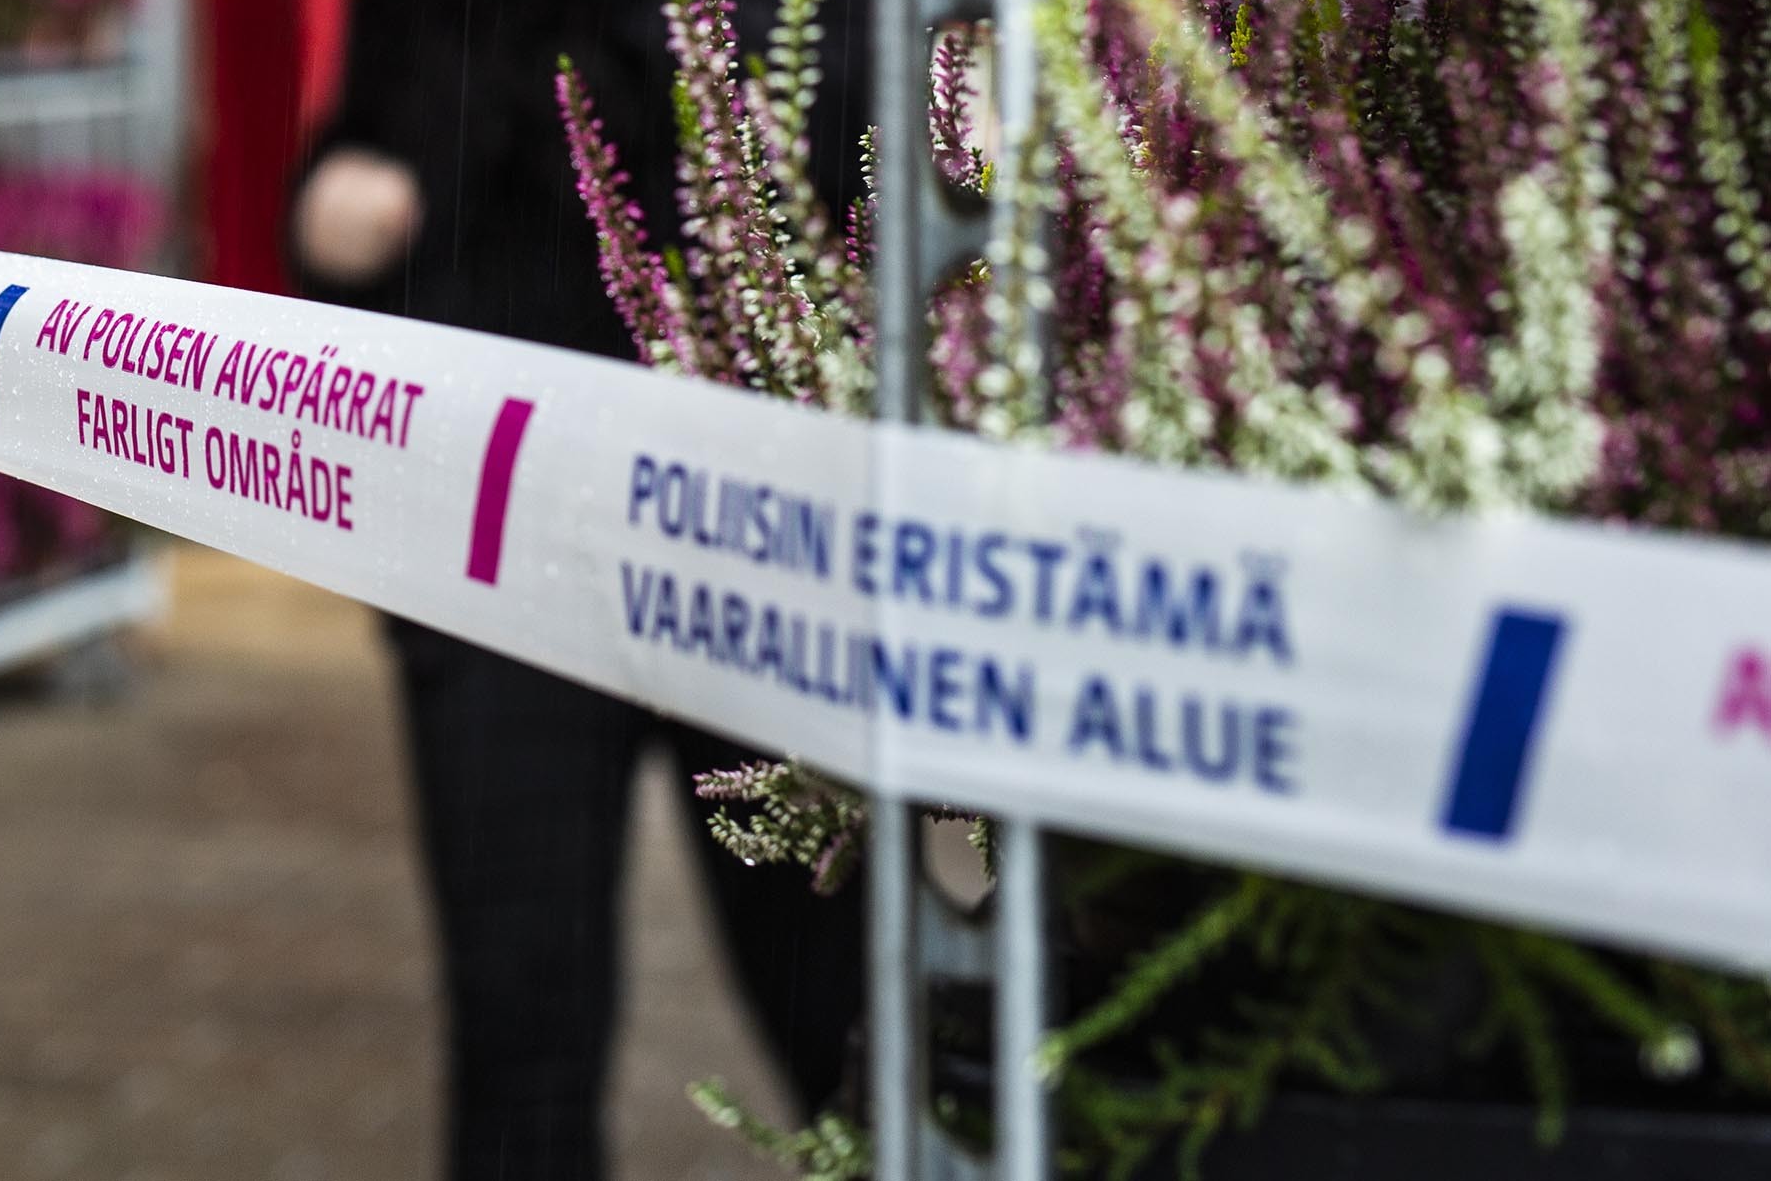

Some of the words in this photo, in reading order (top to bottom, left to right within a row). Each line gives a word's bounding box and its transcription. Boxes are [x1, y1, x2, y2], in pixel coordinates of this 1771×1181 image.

[36, 299, 93, 356] AV
[83, 308, 219, 392] POLISEN
[213, 344, 424, 450] AVSPÄRRAT
[77, 388, 194, 480] FARLIGT
[205, 428, 353, 532] OMRÅDE
[628, 453, 835, 579] POLIISIN
[850, 509, 1298, 669] ERISTÄMÄ
[620, 557, 1036, 747] VAARALLINEN
[1066, 672, 1301, 797] ALUE
[1708, 645, 1771, 751] A
